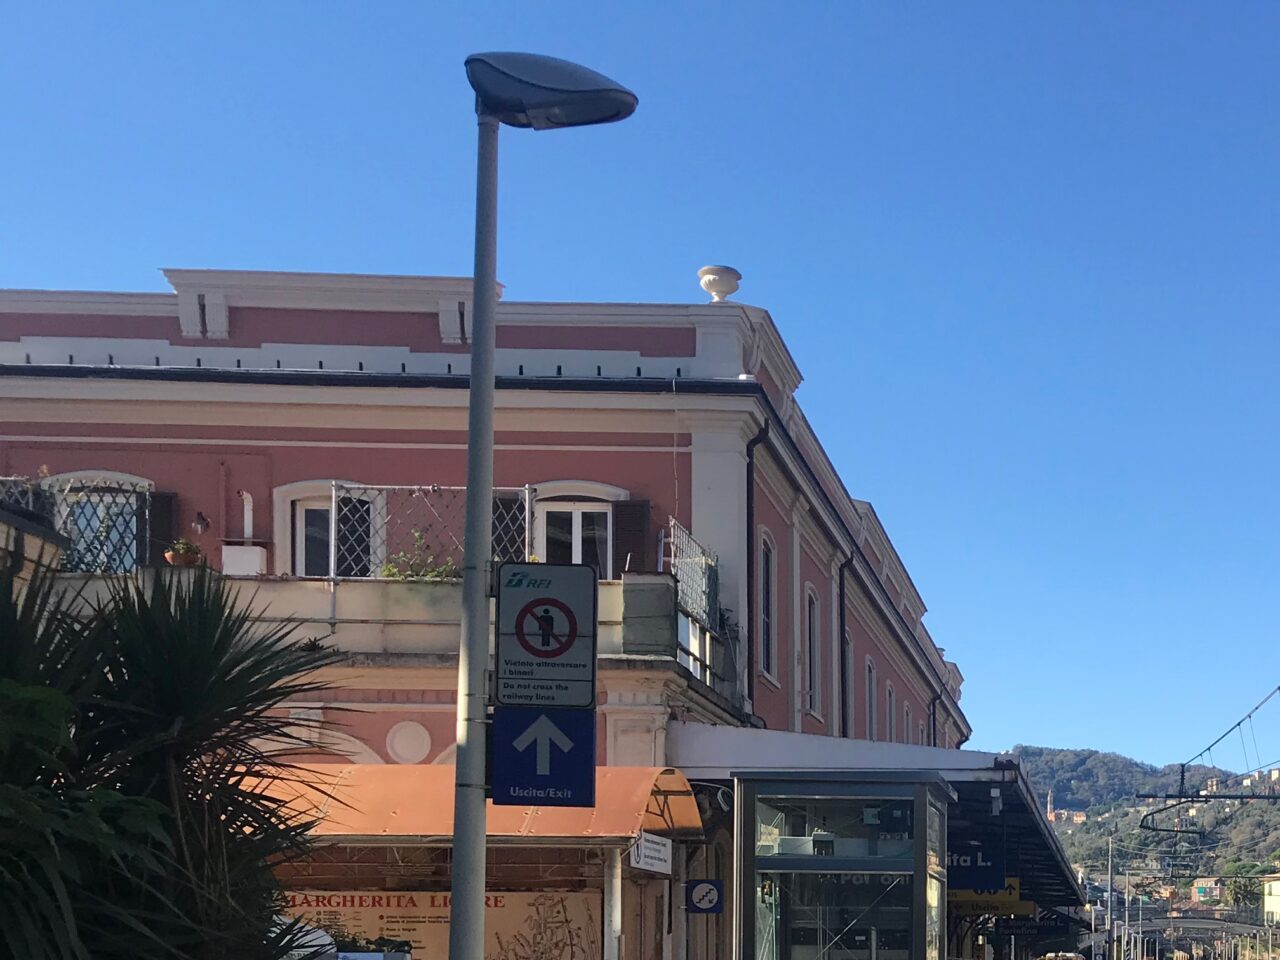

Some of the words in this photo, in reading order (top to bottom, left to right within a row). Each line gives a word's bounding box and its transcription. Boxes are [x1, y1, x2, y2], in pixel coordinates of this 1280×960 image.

[526, 579, 552, 589] RFI
[504, 659, 534, 668] Vietato
[536, 660, 588, 669] attraversare
[508, 668, 534, 677] binari
[533, 683, 553, 691] cross
[555, 683, 569, 691] the
[503, 693, 534, 704] railway
[535, 693, 556, 702] lines
[509, 786, 572, 799] Uscita/Exit
